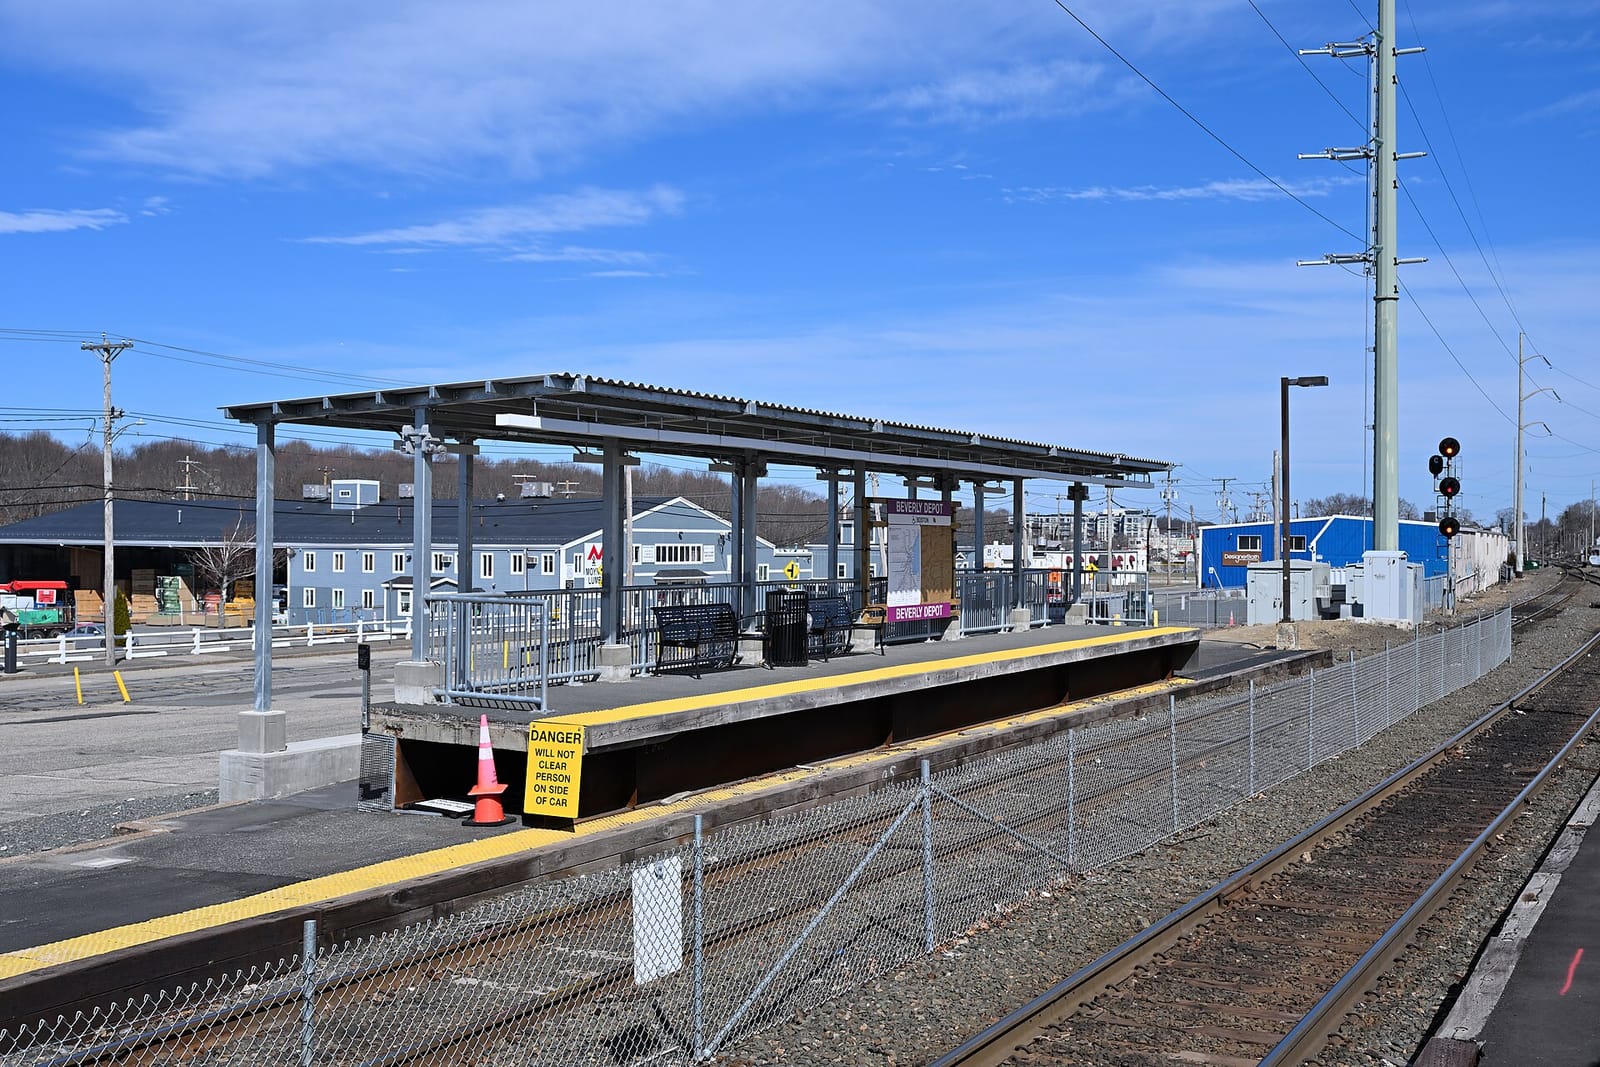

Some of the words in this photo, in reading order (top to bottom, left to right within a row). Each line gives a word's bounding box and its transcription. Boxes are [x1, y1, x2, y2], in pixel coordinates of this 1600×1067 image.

[896, 501, 923, 513] BEVERLY
[924, 502, 944, 514] DEPOT
[896, 606, 923, 620] BEVERLY
[924, 605, 943, 617] DEPOT
[531, 730, 581, 744] DANGER
[535, 748, 555, 758] WILL
[557, 750, 575, 759] NOT
[538, 760, 567, 771] CLEAR
[535, 772, 571, 783] PERSON
[533, 784, 547, 793] ON
[548, 785, 569, 795] SIDE
[535, 796, 547, 805] OF
[549, 797, 568, 807] CAR
